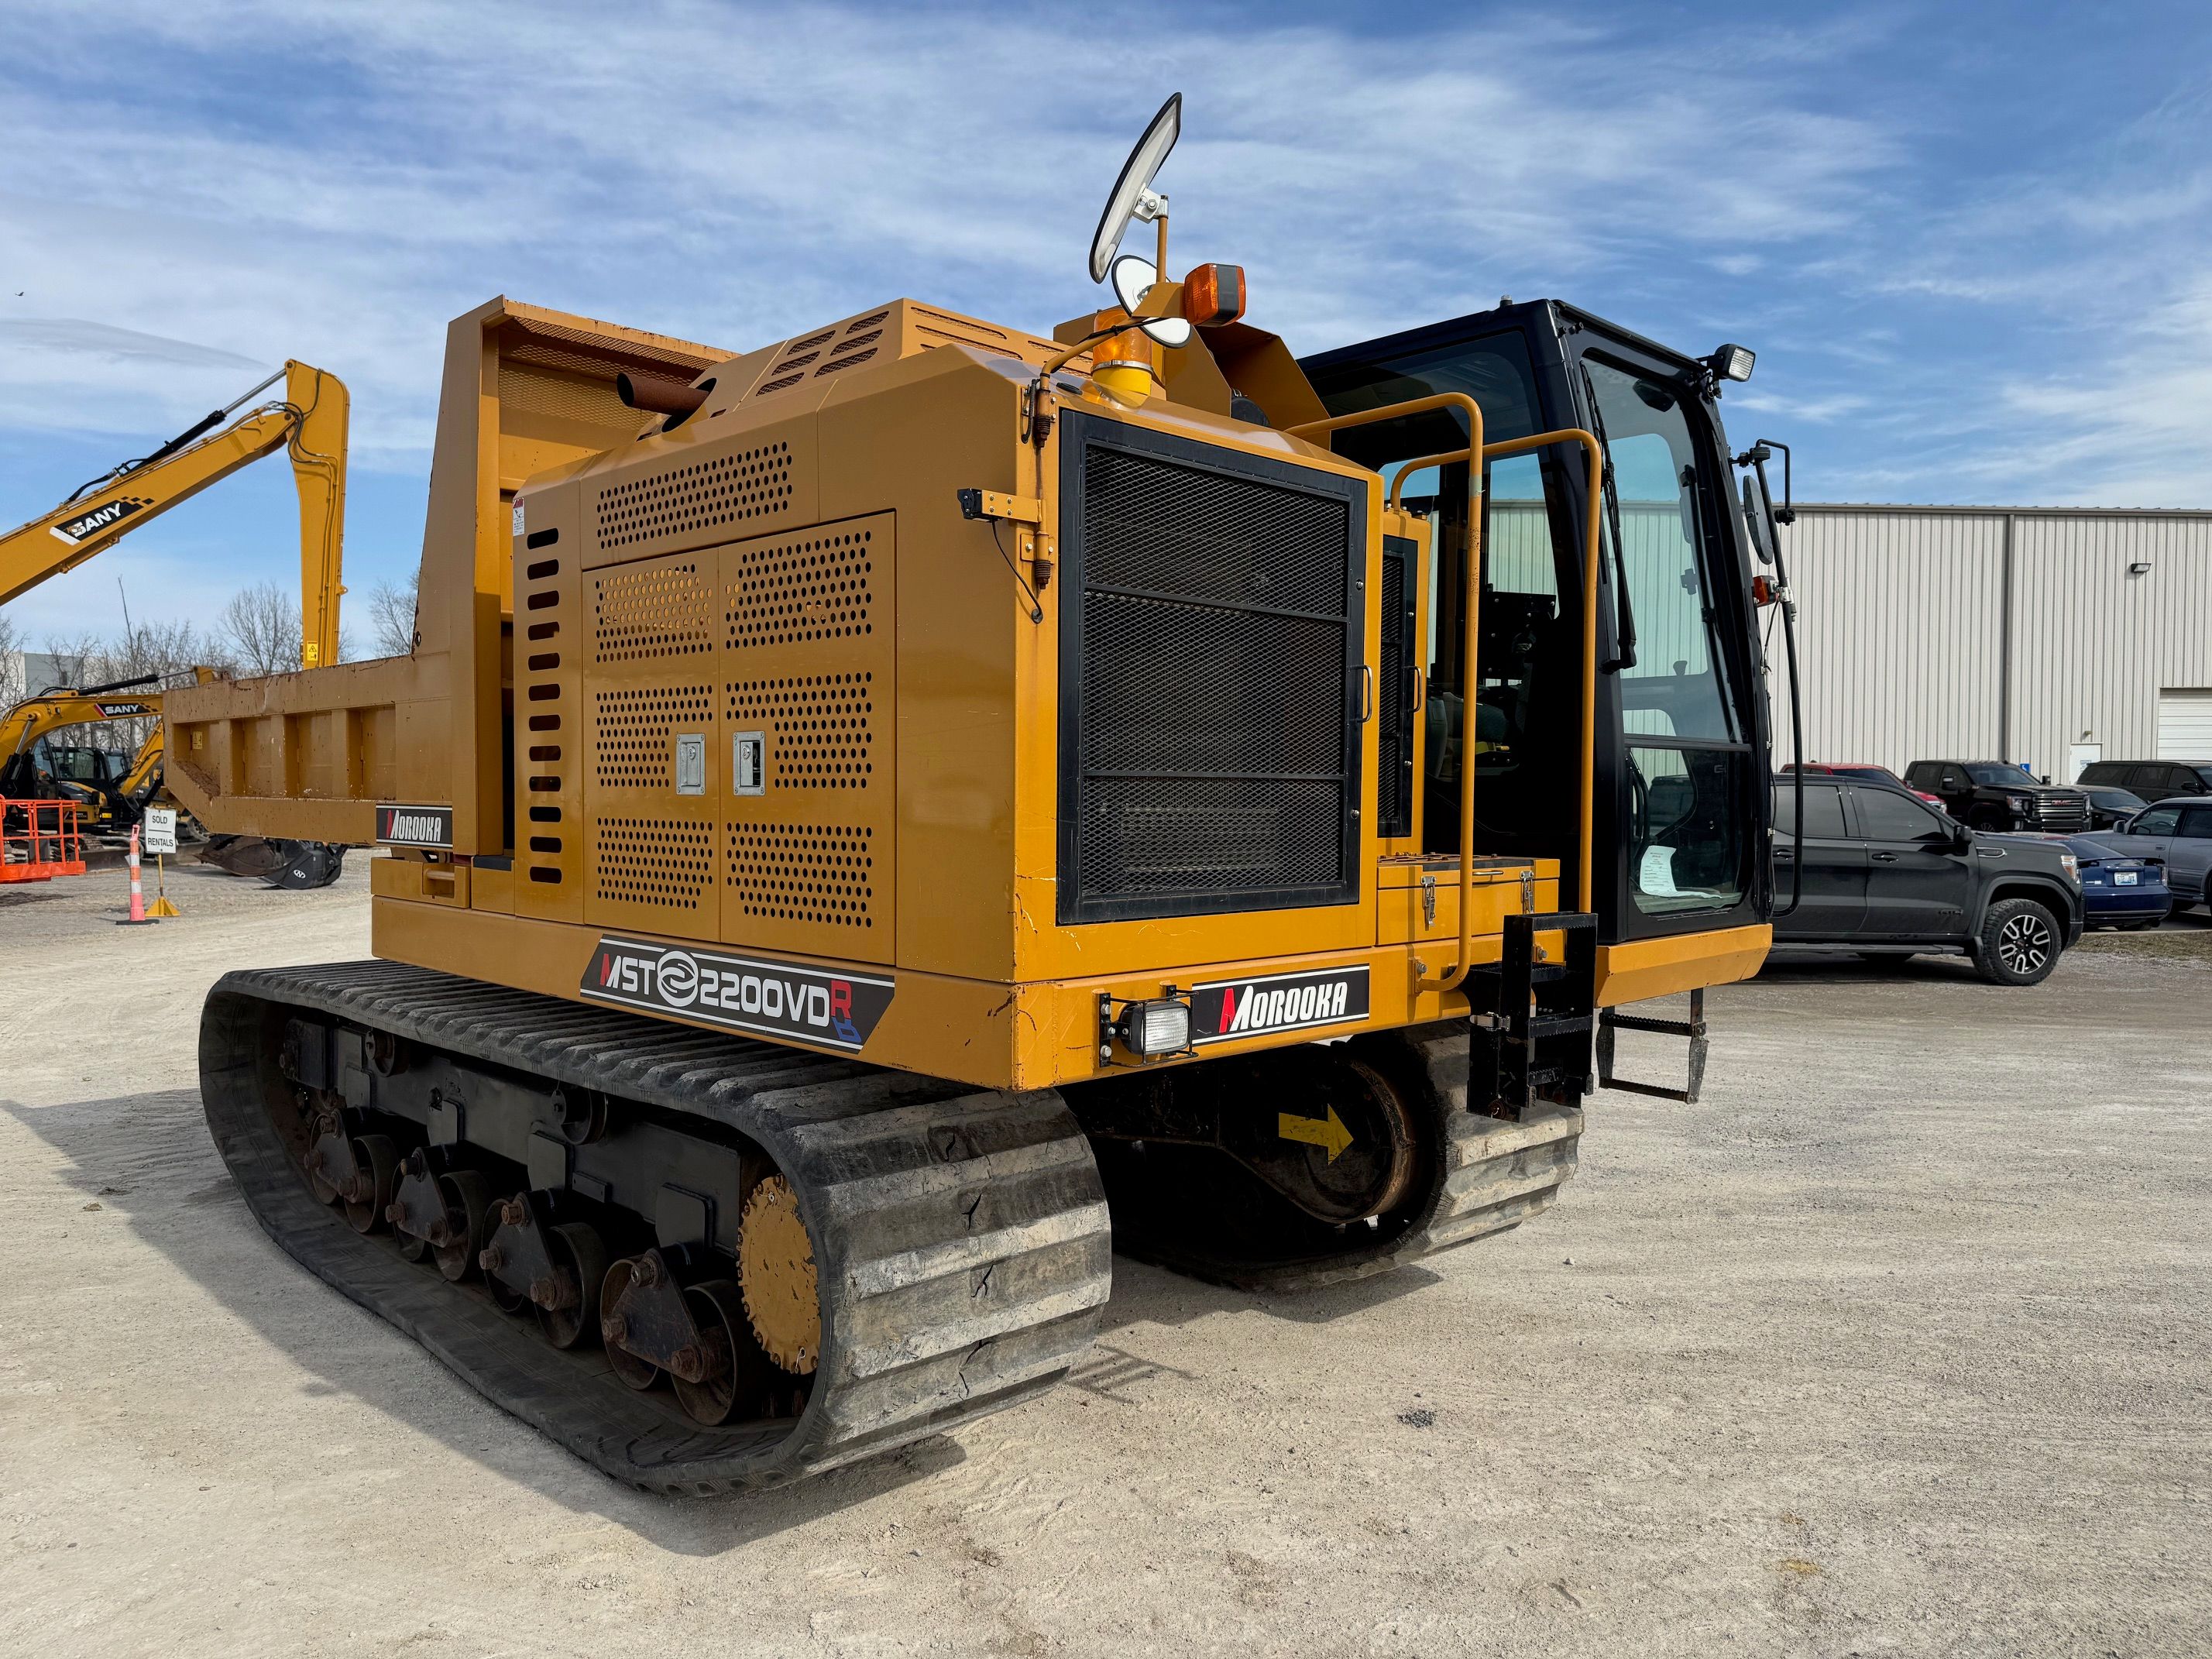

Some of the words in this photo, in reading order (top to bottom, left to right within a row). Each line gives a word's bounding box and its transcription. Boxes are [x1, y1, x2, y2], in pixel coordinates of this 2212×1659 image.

[70, 503, 121, 538] SANY
[105, 705, 139, 714] SANY
[152, 816, 168, 824] SOLD
[148, 837, 173, 847] RENTALS
